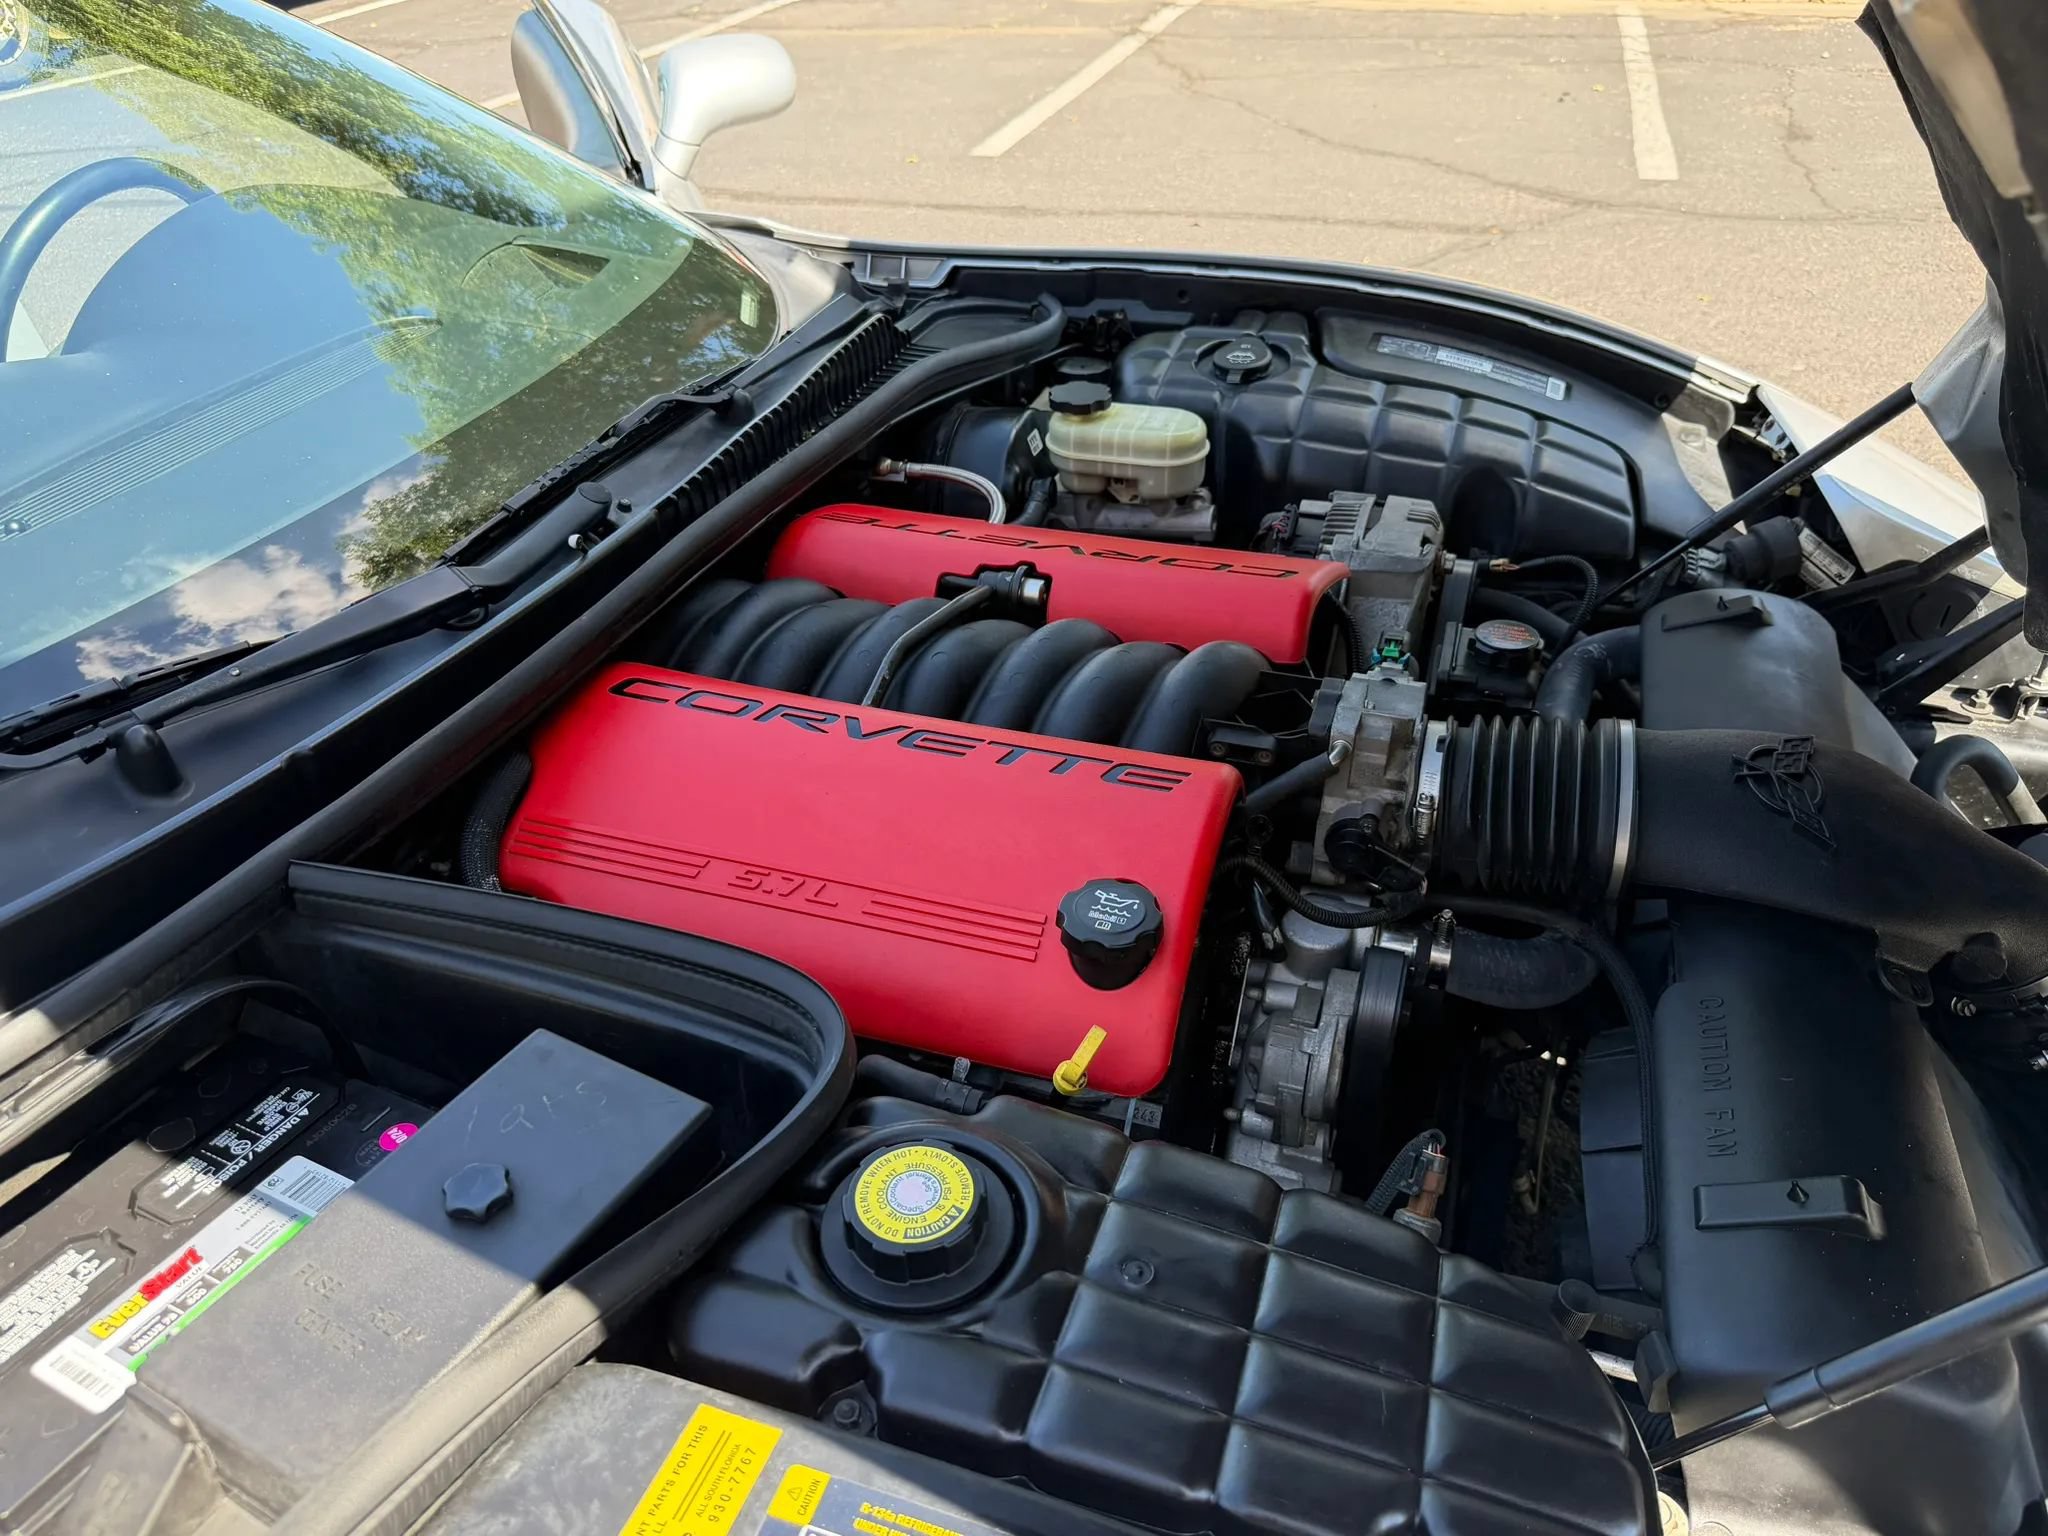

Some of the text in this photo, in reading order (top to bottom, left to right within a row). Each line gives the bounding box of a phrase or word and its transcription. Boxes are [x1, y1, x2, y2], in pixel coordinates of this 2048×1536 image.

[821, 513, 1300, 578] CORVETTE
[607, 676, 1193, 793] CORVETTE
[726, 866, 839, 908] 5.7L
[1699, 995, 1738, 1158] CAUTION FAN
[253, 1116, 301, 1152] DANGER
[201, 1159, 248, 1193] POISON
[859, 1149, 970, 1237] CAUTION DO NOT REMOVE WHEN HOT REMOVE SLOWLY
[876, 1167, 927, 1224] ENGINE COOLANT
[903, 1162, 951, 1211] 15 PSI PRESSURE
[86, 1249, 206, 1338] EverStart
[648, 1479, 676, 1516] PARTS
[672, 1452, 692, 1476] FOR
[687, 1424, 708, 1449] THIS
[695, 1503, 709, 1518] ALL
[704, 1475, 725, 1501] SOUTH
[708, 1447, 757, 1523] 930-7767
[797, 1478, 822, 1516] CAUTION
